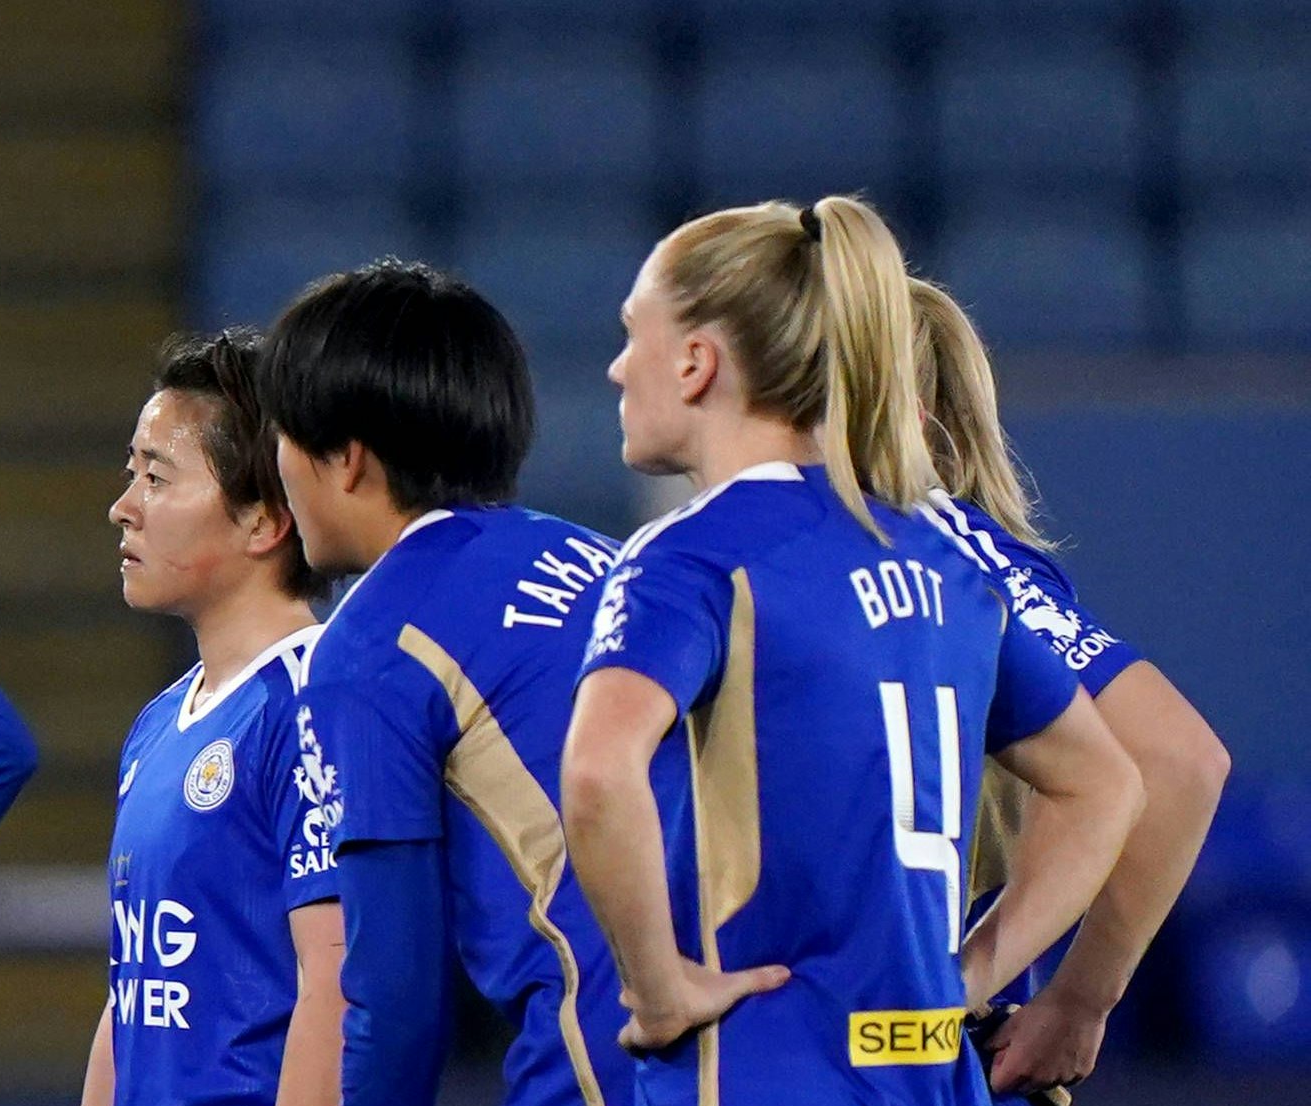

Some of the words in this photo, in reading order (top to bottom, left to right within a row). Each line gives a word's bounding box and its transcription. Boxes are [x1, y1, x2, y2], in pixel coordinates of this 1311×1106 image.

[503, 537, 620, 628] TAKA
[849, 559, 944, 630] BOTT
[1065, 629, 1119, 671] GON
[879, 681, 962, 955] 4
